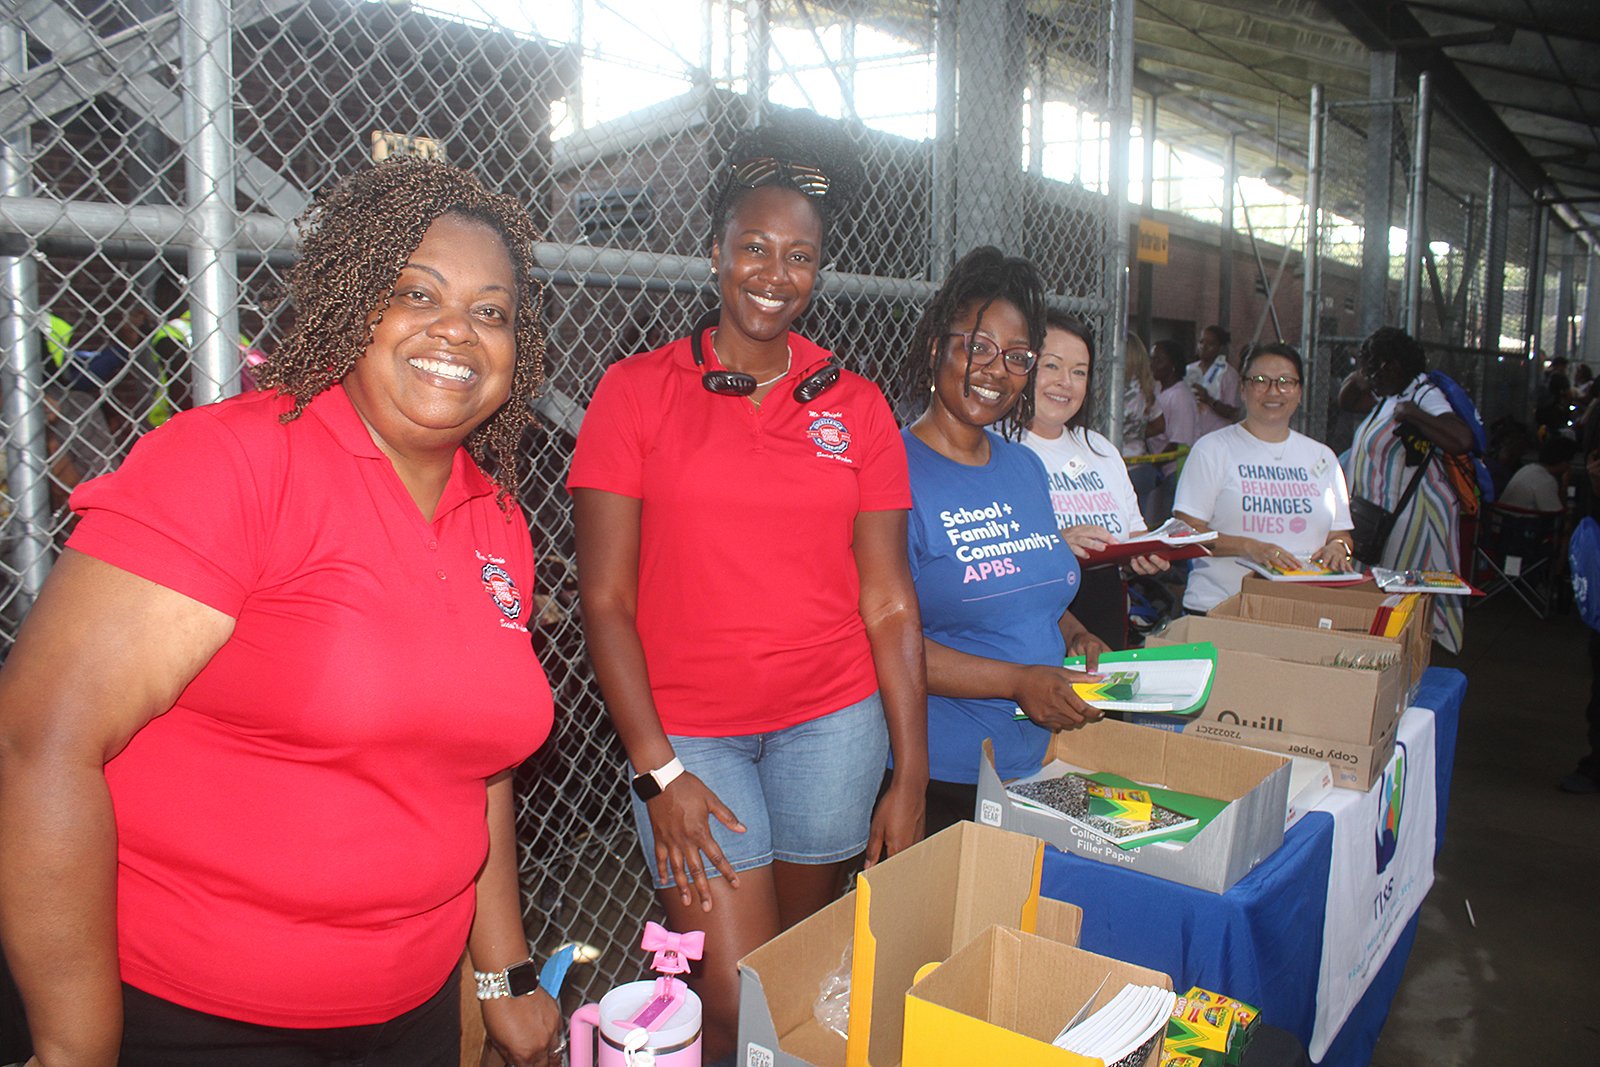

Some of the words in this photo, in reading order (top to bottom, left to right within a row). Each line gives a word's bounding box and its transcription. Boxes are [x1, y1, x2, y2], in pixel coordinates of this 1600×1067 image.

[1048, 470, 1105, 492] HANING
[1238, 464, 1308, 481] CHANGING
[1241, 480, 1321, 497] BEHAVIORS
[1242, 495, 1313, 514] CHANGES
[1242, 514, 1285, 534] LIVES
[962, 557, 1022, 584] APBS.
[1195, 724, 1243, 740] 720222CT
[1288, 744, 1324, 759] Paper
[1327, 750, 1359, 765] Copy
[1076, 840, 1103, 855] Filler
[1105, 846, 1136, 863] Paper
